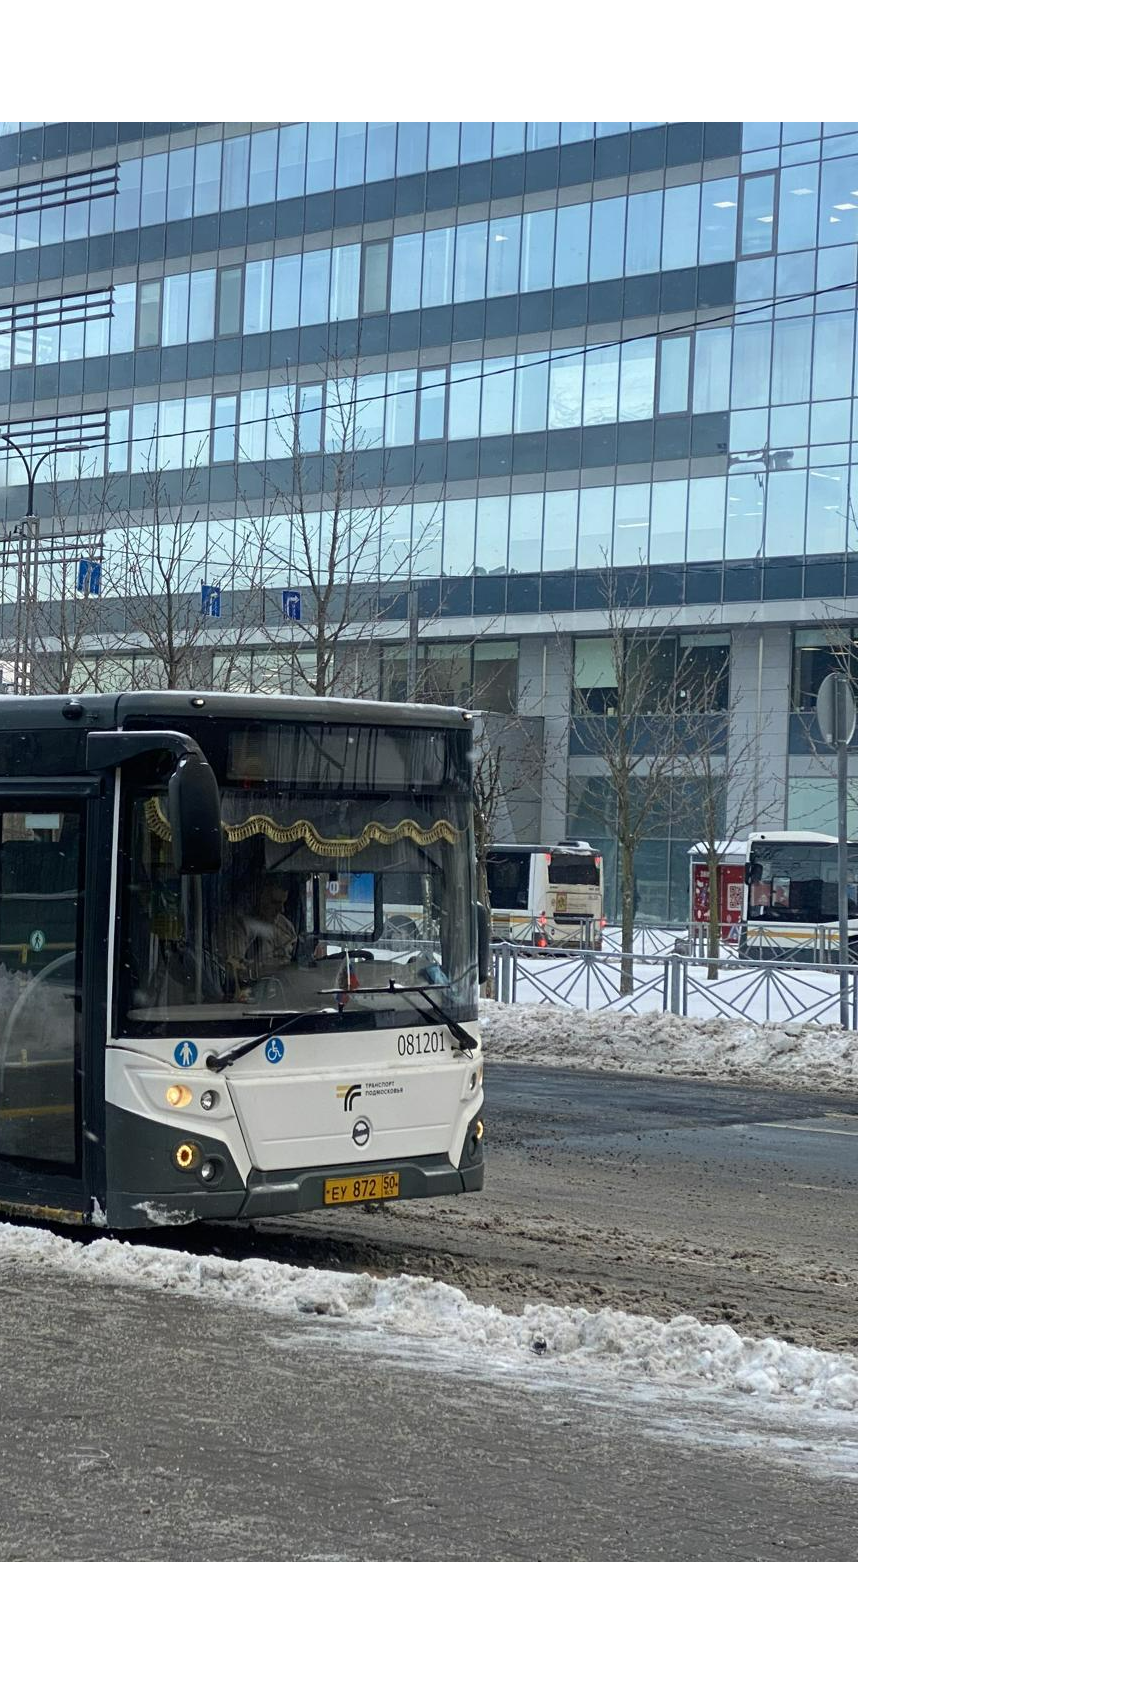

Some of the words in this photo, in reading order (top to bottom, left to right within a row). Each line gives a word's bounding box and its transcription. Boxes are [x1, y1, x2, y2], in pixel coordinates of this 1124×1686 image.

[397, 1031, 446, 1056] 081201
[365, 1081, 395, 1089] ТРАНСПОРТ
[365, 1087, 404, 1097] ПОДМОСКОВЬЯ
[353, 1179, 377, 1198] 872
[383, 1175, 396, 1190] 50
